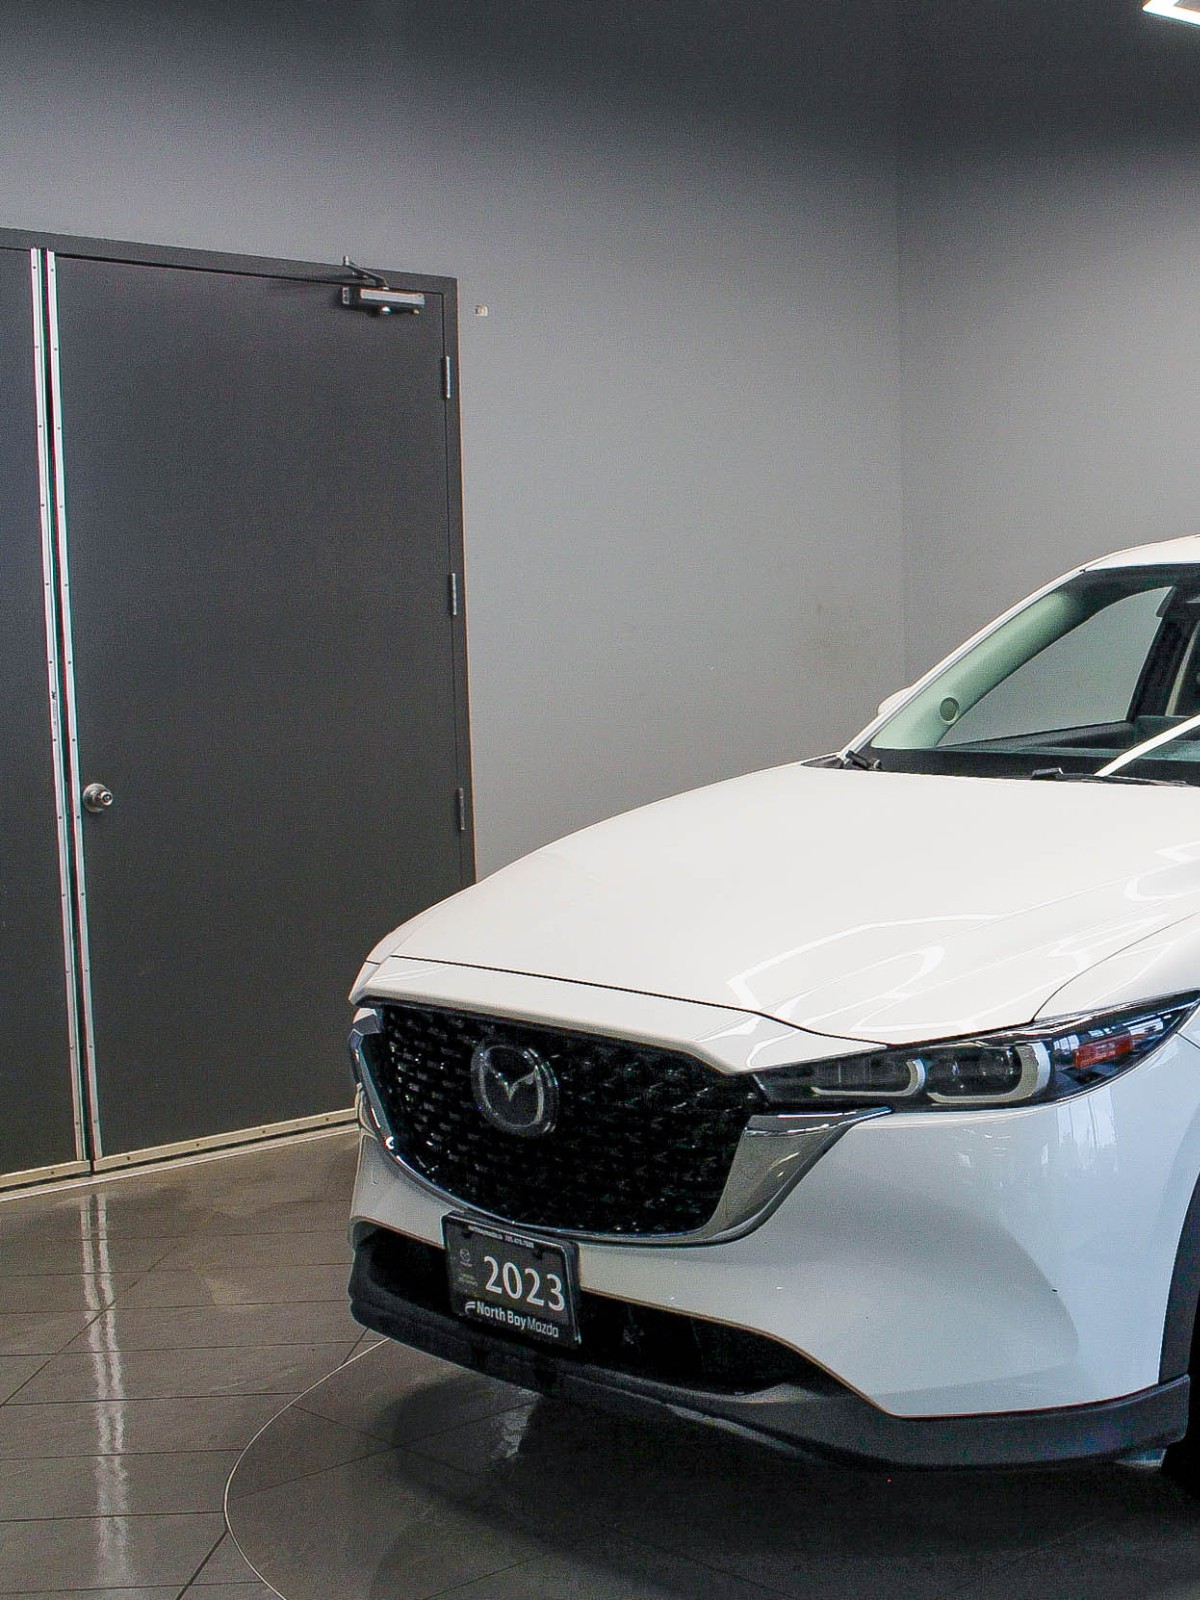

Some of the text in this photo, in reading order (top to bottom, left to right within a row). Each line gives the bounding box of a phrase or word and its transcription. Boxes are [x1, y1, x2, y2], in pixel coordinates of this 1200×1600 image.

[484, 1255, 565, 1311] 2023
[477, 1301, 559, 1338] North Bay Mazda
